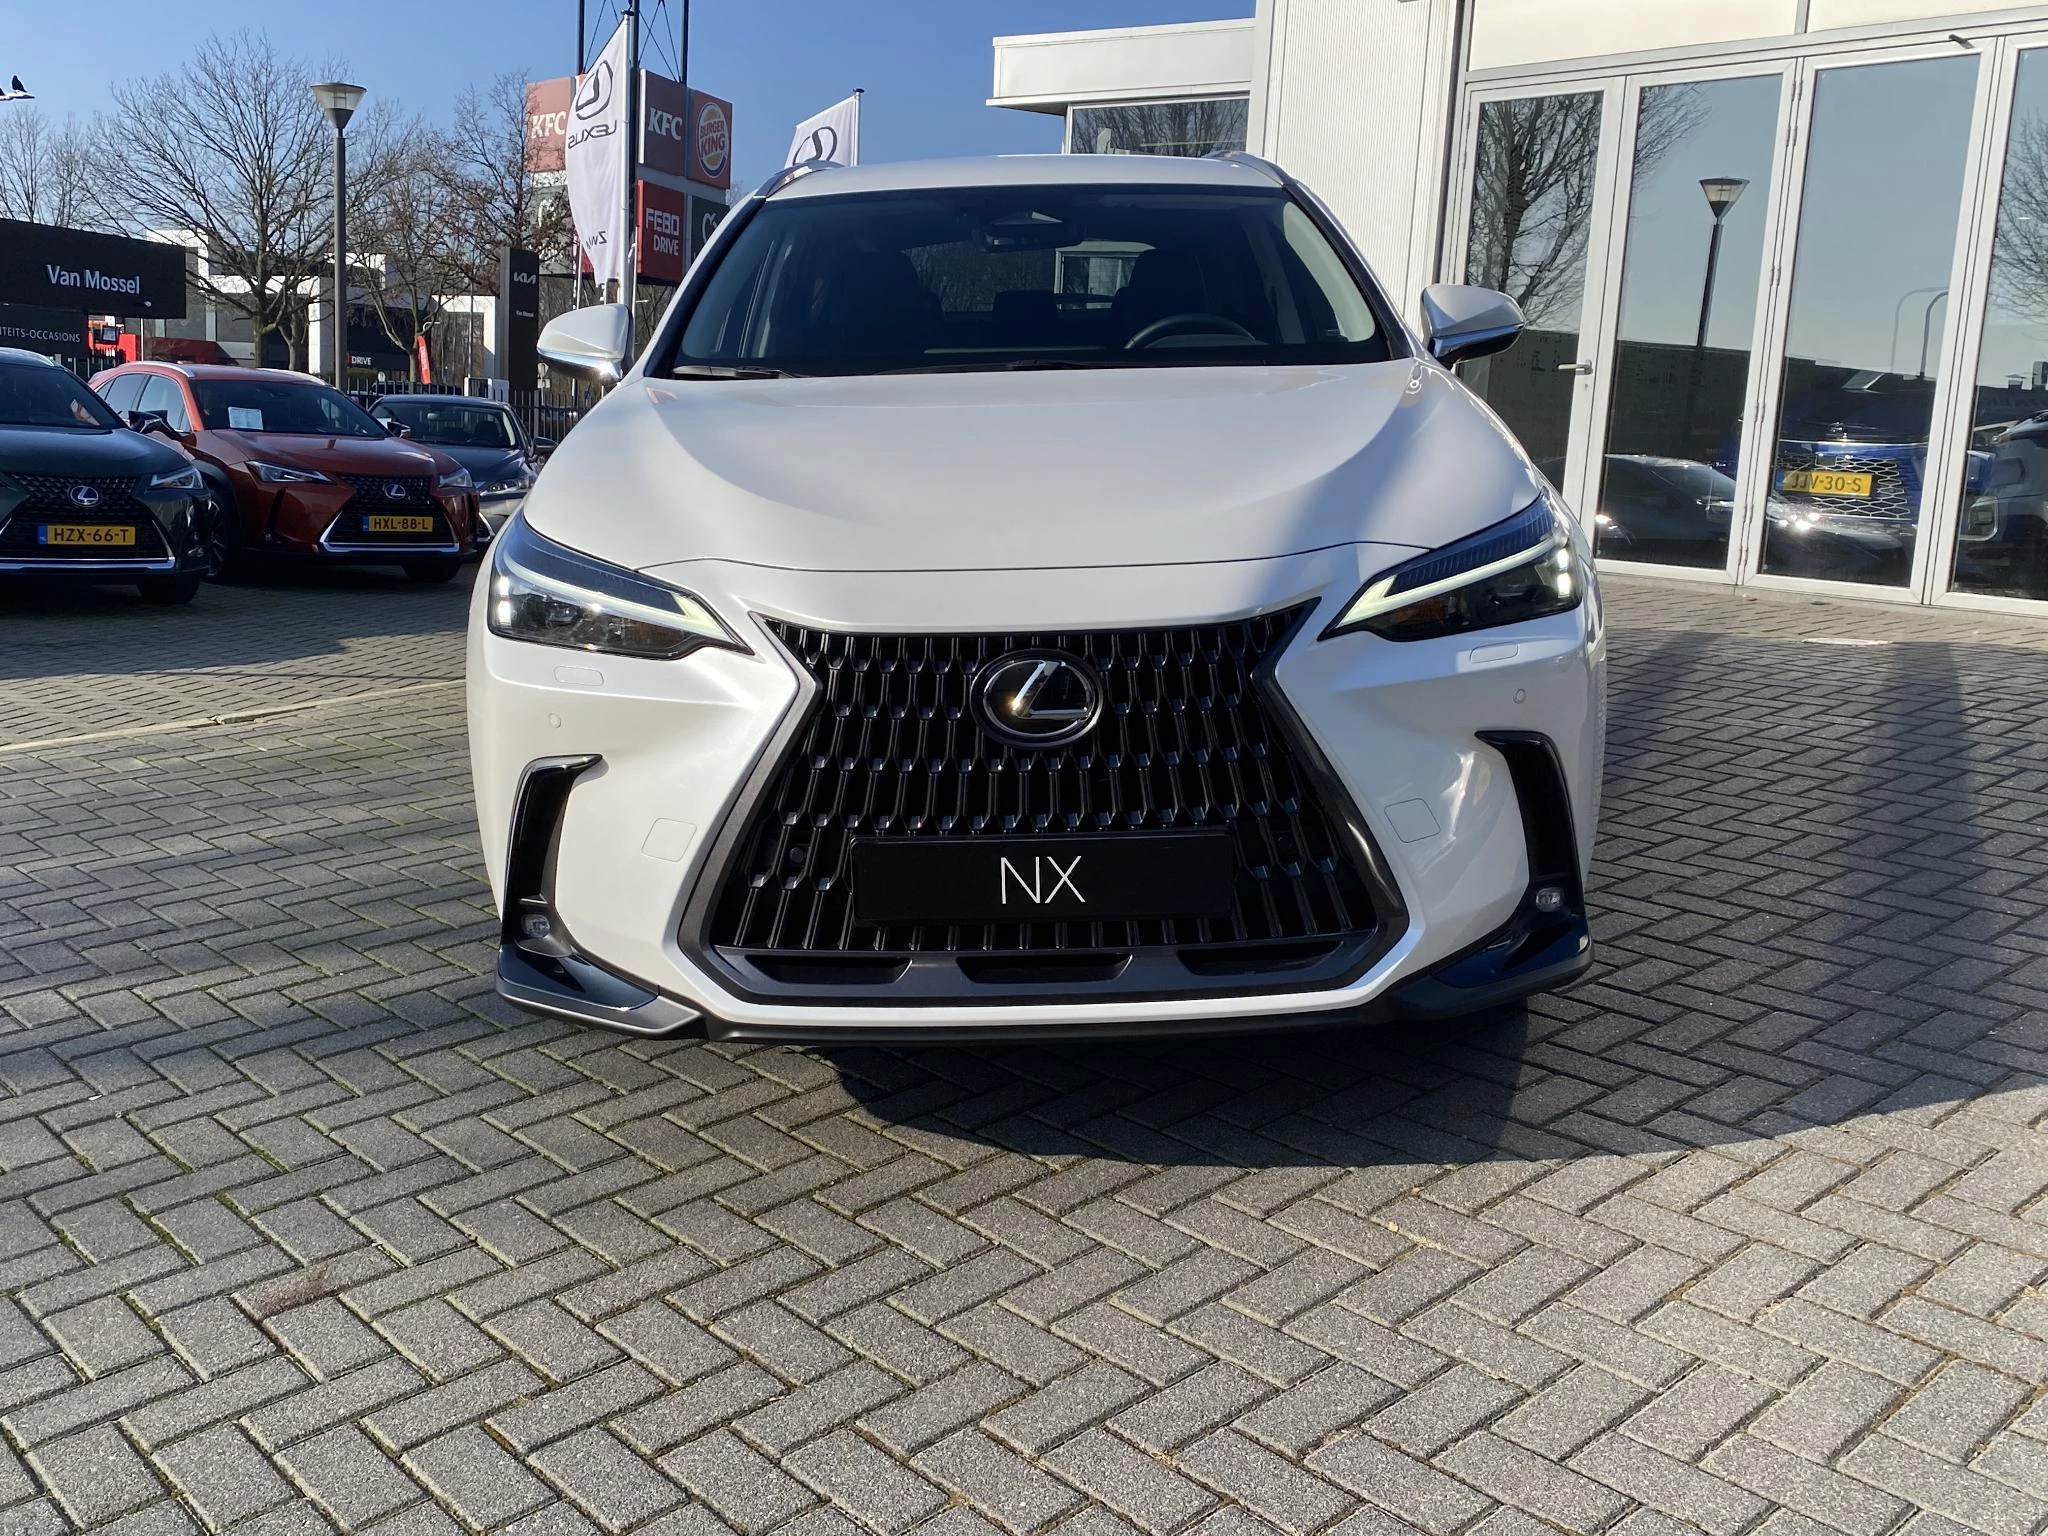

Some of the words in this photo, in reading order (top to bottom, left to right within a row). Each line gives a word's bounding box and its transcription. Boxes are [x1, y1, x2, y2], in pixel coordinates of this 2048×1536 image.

[531, 111, 566, 139] KFC
[648, 107, 683, 140] KFC
[700, 120, 725, 138] BURGER
[700, 133, 725, 157] KING
[646, 207, 680, 236] FEBO
[653, 234, 679, 256] DRIVE
[47, 264, 81, 287] Van
[85, 269, 140, 294] Mossel
[351, 356, 372, 366] DRIVE
[1791, 474, 1863, 492] JJV-30-S
[54, 527, 129, 542] HZX-66-T
[373, 517, 429, 530] HXL-88-L
[1001, 855, 1086, 904] NX
